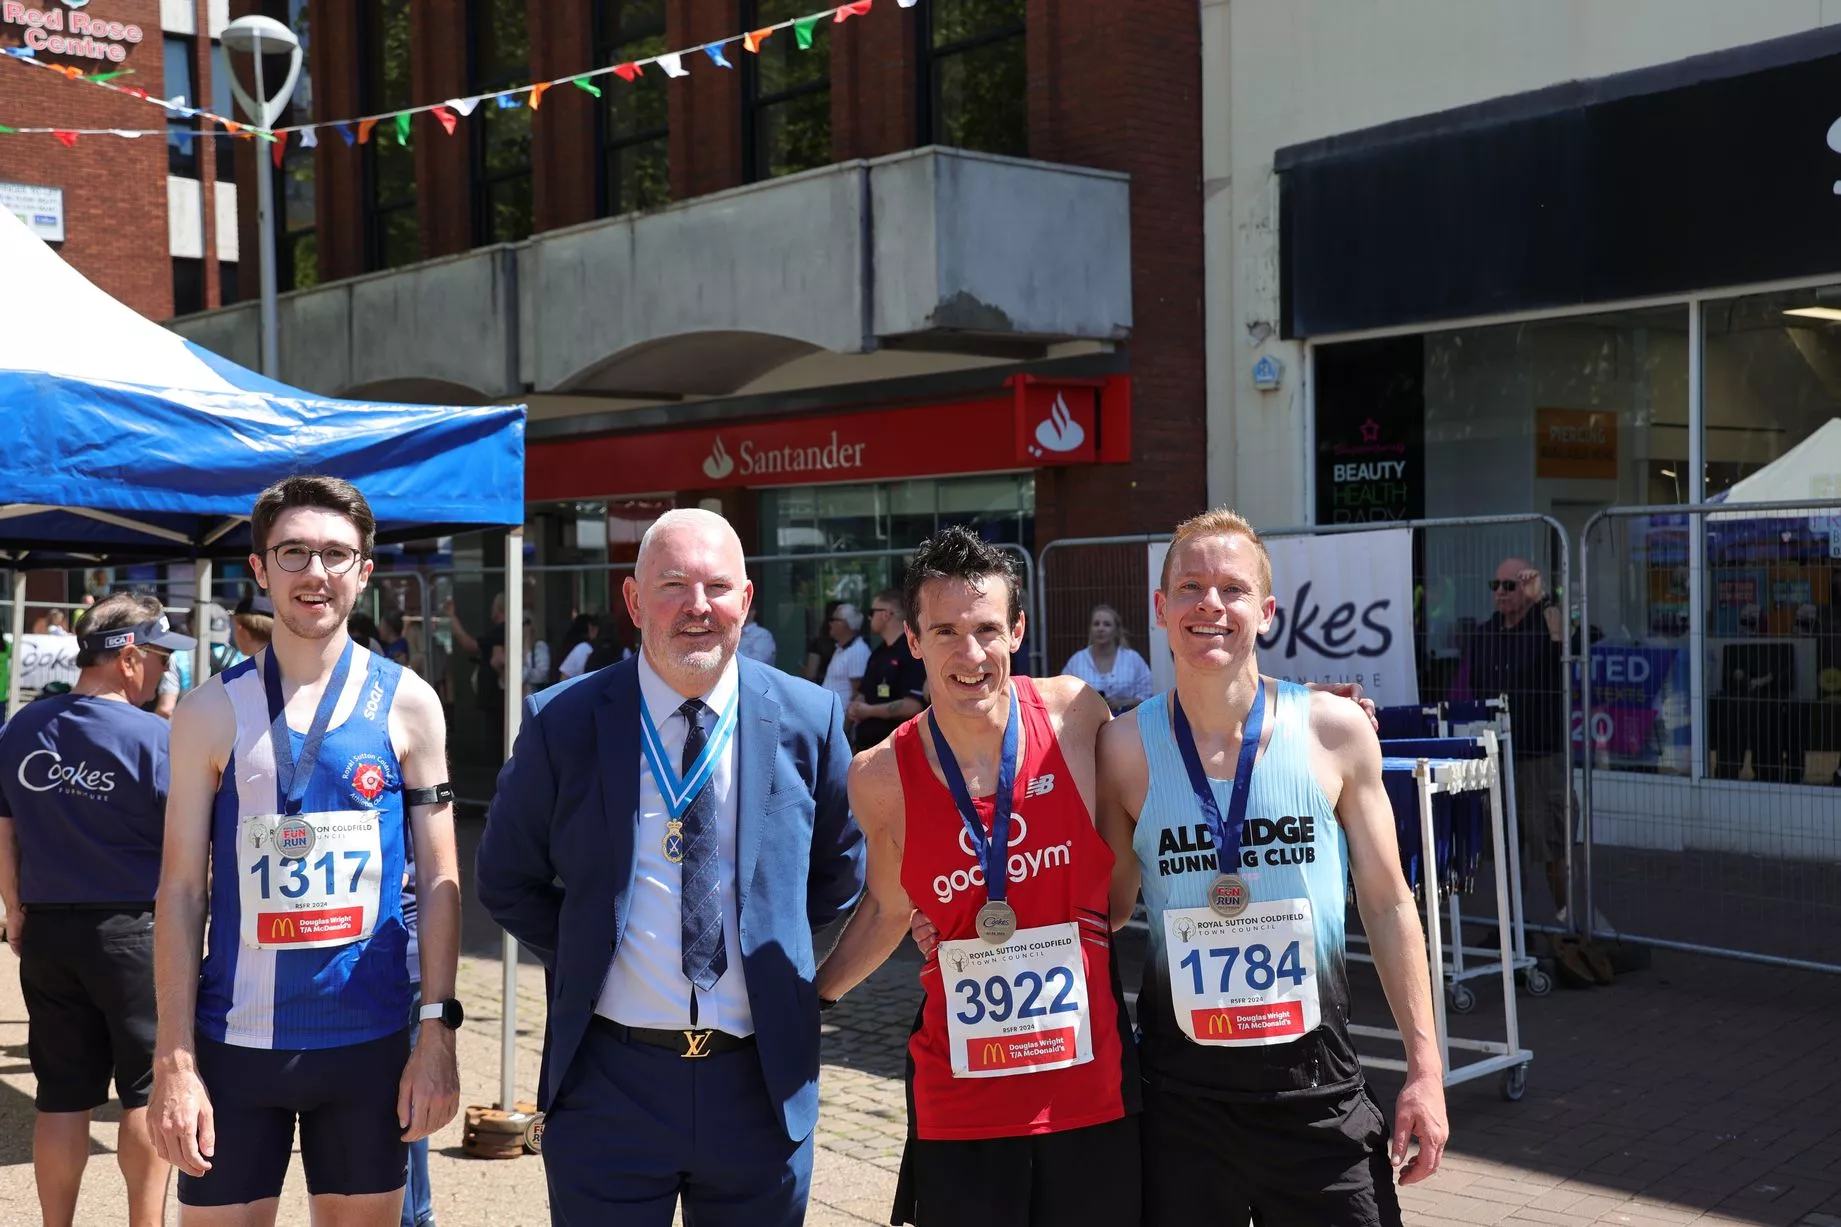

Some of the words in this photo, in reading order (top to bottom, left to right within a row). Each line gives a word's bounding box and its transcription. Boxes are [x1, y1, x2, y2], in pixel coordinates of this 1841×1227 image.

[3, 1, 63, 31] Red
[68, 11, 143, 42] Rose
[24, 28, 126, 62] Centre
[739, 431, 865, 476] Santander
[1334, 461, 1406, 482] BEAUTY
[1334, 483, 1406, 506] HEALTH
[1256, 580, 1393, 659] okes
[21, 641, 78, 676] ooke
[1575, 654, 1650, 682] ITED
[364, 681, 384, 720] soar
[18, 750, 115, 792] Cookes
[342, 759, 354, 780] Royal
[353, 752, 376, 762] Sutton
[284, 829, 306, 838] FUN
[332, 824, 373, 833] COLDFIELD
[1158, 816, 1315, 856] ALDIDGE
[284, 838, 306, 847] RUN
[1158, 850, 1258, 876] RUNNG
[1264, 847, 1316, 866] CLUB
[251, 850, 371, 900] 1317
[933, 846, 1070, 904] googym
[1216, 896, 1240, 905] RUN
[300, 918, 329, 926] Douglas
[330, 916, 352, 924] Wright
[313, 922, 352, 932] McDonald's
[1225, 917, 1258, 926] SUTTON
[1260, 914, 1304, 924] COLDFIELD
[1232, 924, 1276, 933] COUNCIL
[969, 950, 995, 960] ROYAL
[996, 944, 1028, 954] SUTTON
[1029, 938, 1072, 950] COLDFIELD
[971, 958, 997, 966] TOWN
[1002, 952, 1044, 962] COUNCIL
[1180, 940, 1306, 994] 1784
[955, 966, 1078, 1025] 3922
[1236, 1014, 1266, 1022] Douglas
[1267, 1011, 1290, 1020] Wright
[1251, 1020, 1291, 1029] McDonald's
[1020, 1024, 1035, 1032] 2024
[1009, 1042, 1038, 1051] Douglas
[1039, 1037, 1064, 1046] Wright
[1024, 1046, 1065, 1057] McDonald's
